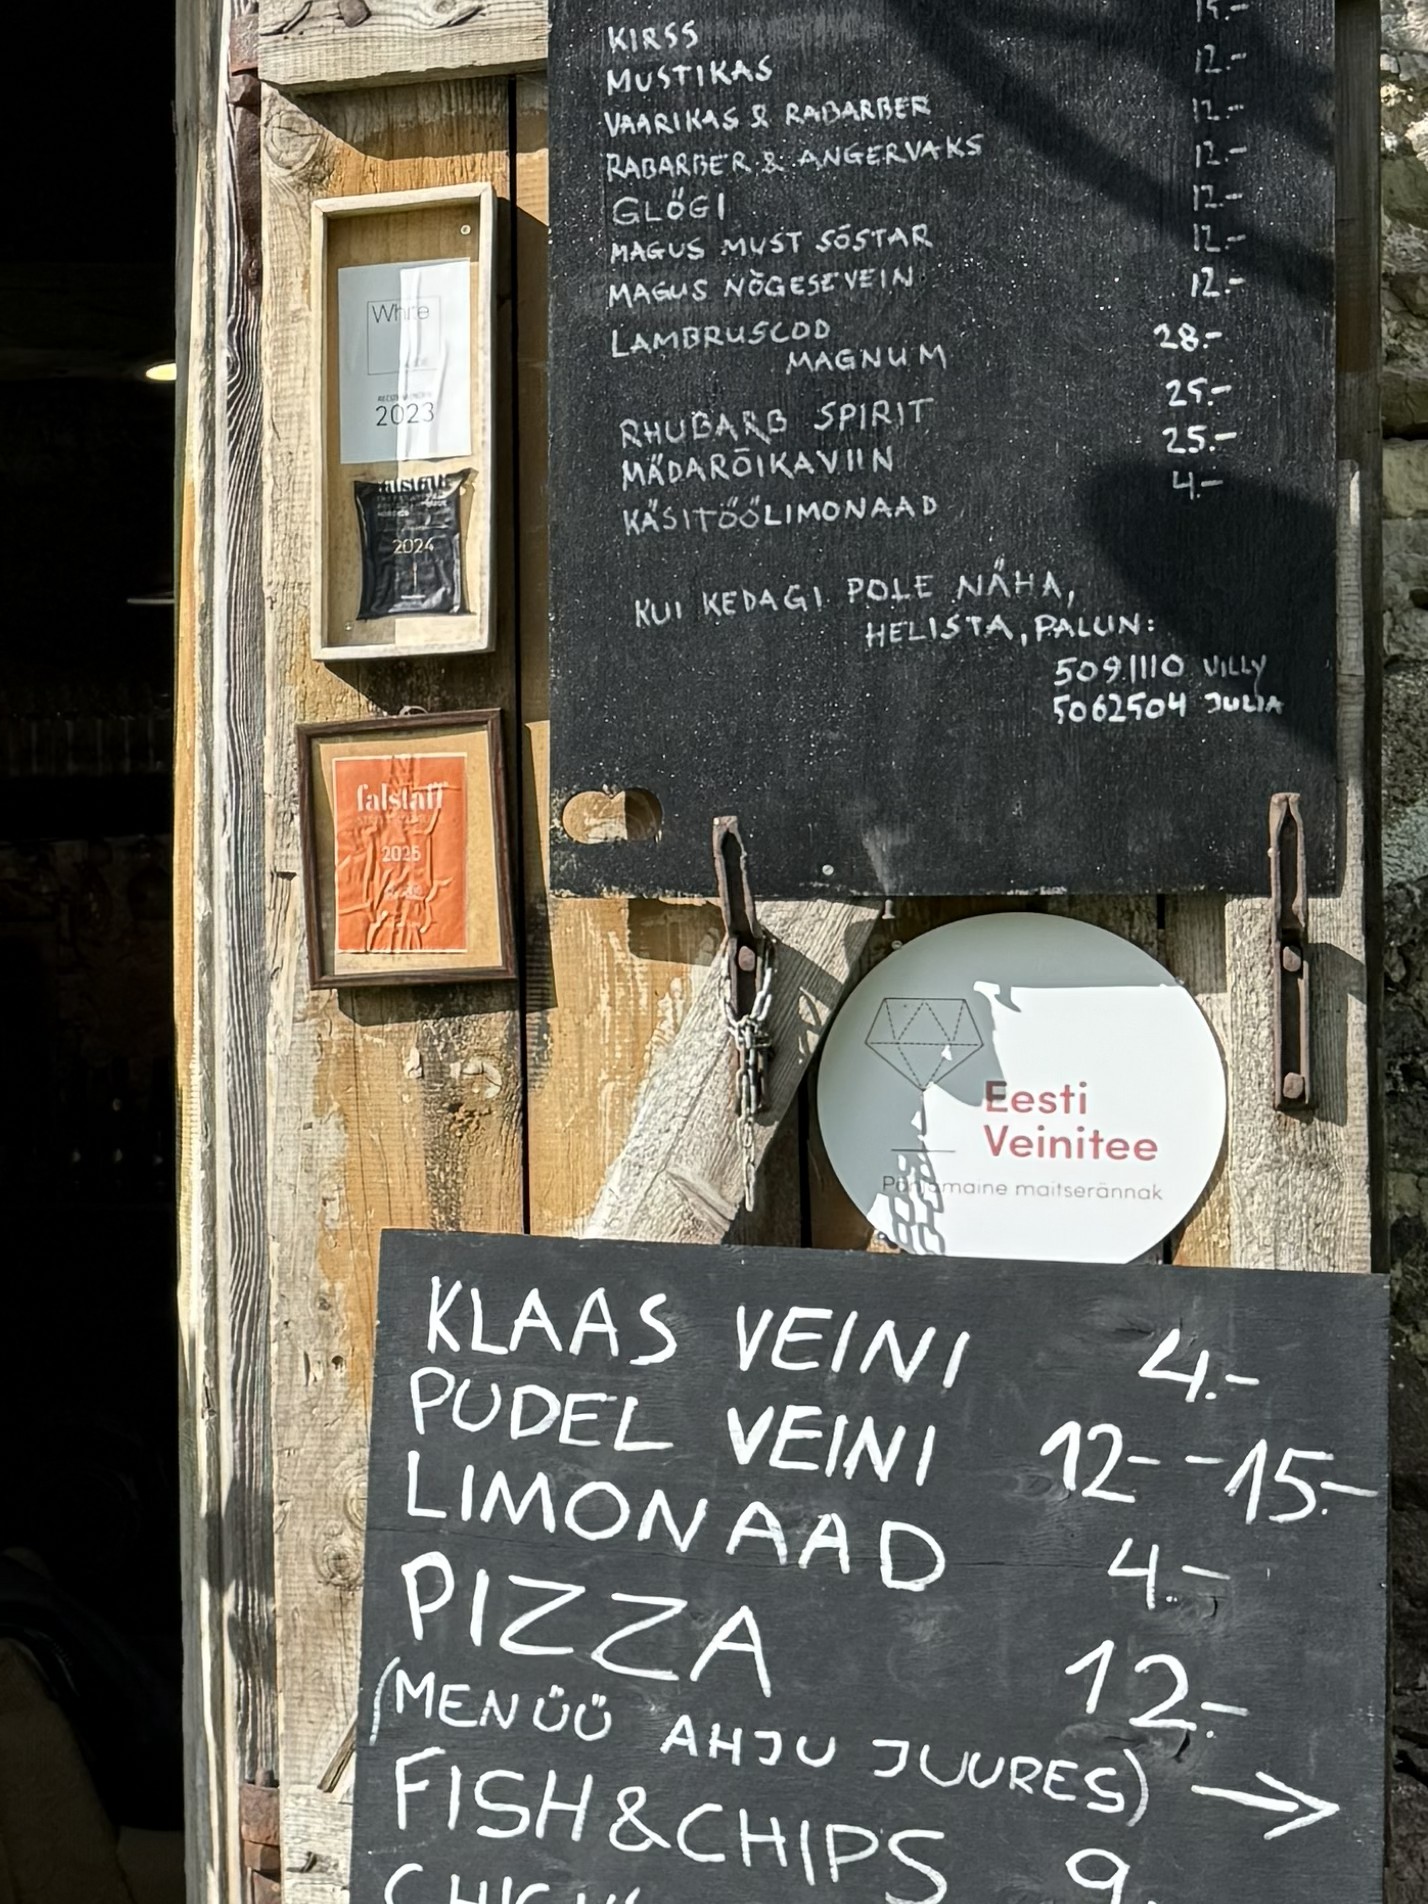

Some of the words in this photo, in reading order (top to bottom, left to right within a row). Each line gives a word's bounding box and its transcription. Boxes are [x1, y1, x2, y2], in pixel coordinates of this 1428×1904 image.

[608, 20, 699, 54] KIRSS
[606, 54, 773, 96] MUSTIKAS
[1195, 44, 1247, 74] 12.-
[604, 106, 740, 138] VAARIKAS
[750, 104, 768, 129] &
[785, 96, 931, 126] RABARBER
[1192, 97, 1245, 123] 12.-
[606, 151, 752, 182] RABARBER
[762, 151, 783, 174] &
[797, 134, 984, 170] ANGERVAKS
[1196, 140, 1248, 168] 12.-
[612, 186, 726, 226] GLÖGI
[1193, 184, 1243, 212] 12.-
[610, 236, 705, 264] MAGUS
[722, 230, 803, 256] MUST
[816, 223, 933, 251] SÕSTAR
[1193, 223, 1246, 253] 12.-
[608, 278, 708, 308] MAGUS
[1191, 266, 1245, 297] 12.-
[1154, 322, 1223, 352] 28.-
[786, 344, 947, 376] MAGNUM
[1166, 377, 1232, 407] 25.-
[376, 402, 434, 426] 2023
[618, 408, 788, 449] RHUBARB
[814, 398, 934, 431] SPIRIT
[1162, 425, 1237, 453] 25.-
[621, 445, 895, 492] MÄDARÕIKAVIIN
[1172, 470, 1224, 500] 4.-
[623, 495, 937, 536] KÄSITÖÖLIMONAAD
[392, 538, 434, 554] 2024
[635, 597, 682, 627] KUI
[702, 584, 823, 616] KEDAGI
[847, 574, 934, 603] POLE
[957, 554, 1075, 608] NÄHA,
[1203, 654, 1267, 695] VILLY
[1053, 692, 1187, 725] 5062504
[1204, 692, 1284, 714] JULIA
[986, 1080, 1087, 1114] Eesti
[984, 1125, 1158, 1161] Veinitee
[1016, 1182, 1163, 1200] maitserännak
[427, 1275, 678, 1366] KLAAS
[736, 1304, 971, 1389] VEINI
[1137, 1325, 1261, 1404] 4.-
[409, 1366, 675, 1451] PUDEL
[726, 1404, 936, 1487] VEINI
[406, 1450, 946, 1591] LIMONAAD
[1107, 1537, 1231, 1611] 4.-
[400, 1551, 773, 1699] PIZZA
[1064, 1638, 1250, 1740] 12.-
[660, 1714, 838, 1768] AHJU
[873, 1737, 1152, 1827] JUURES)
